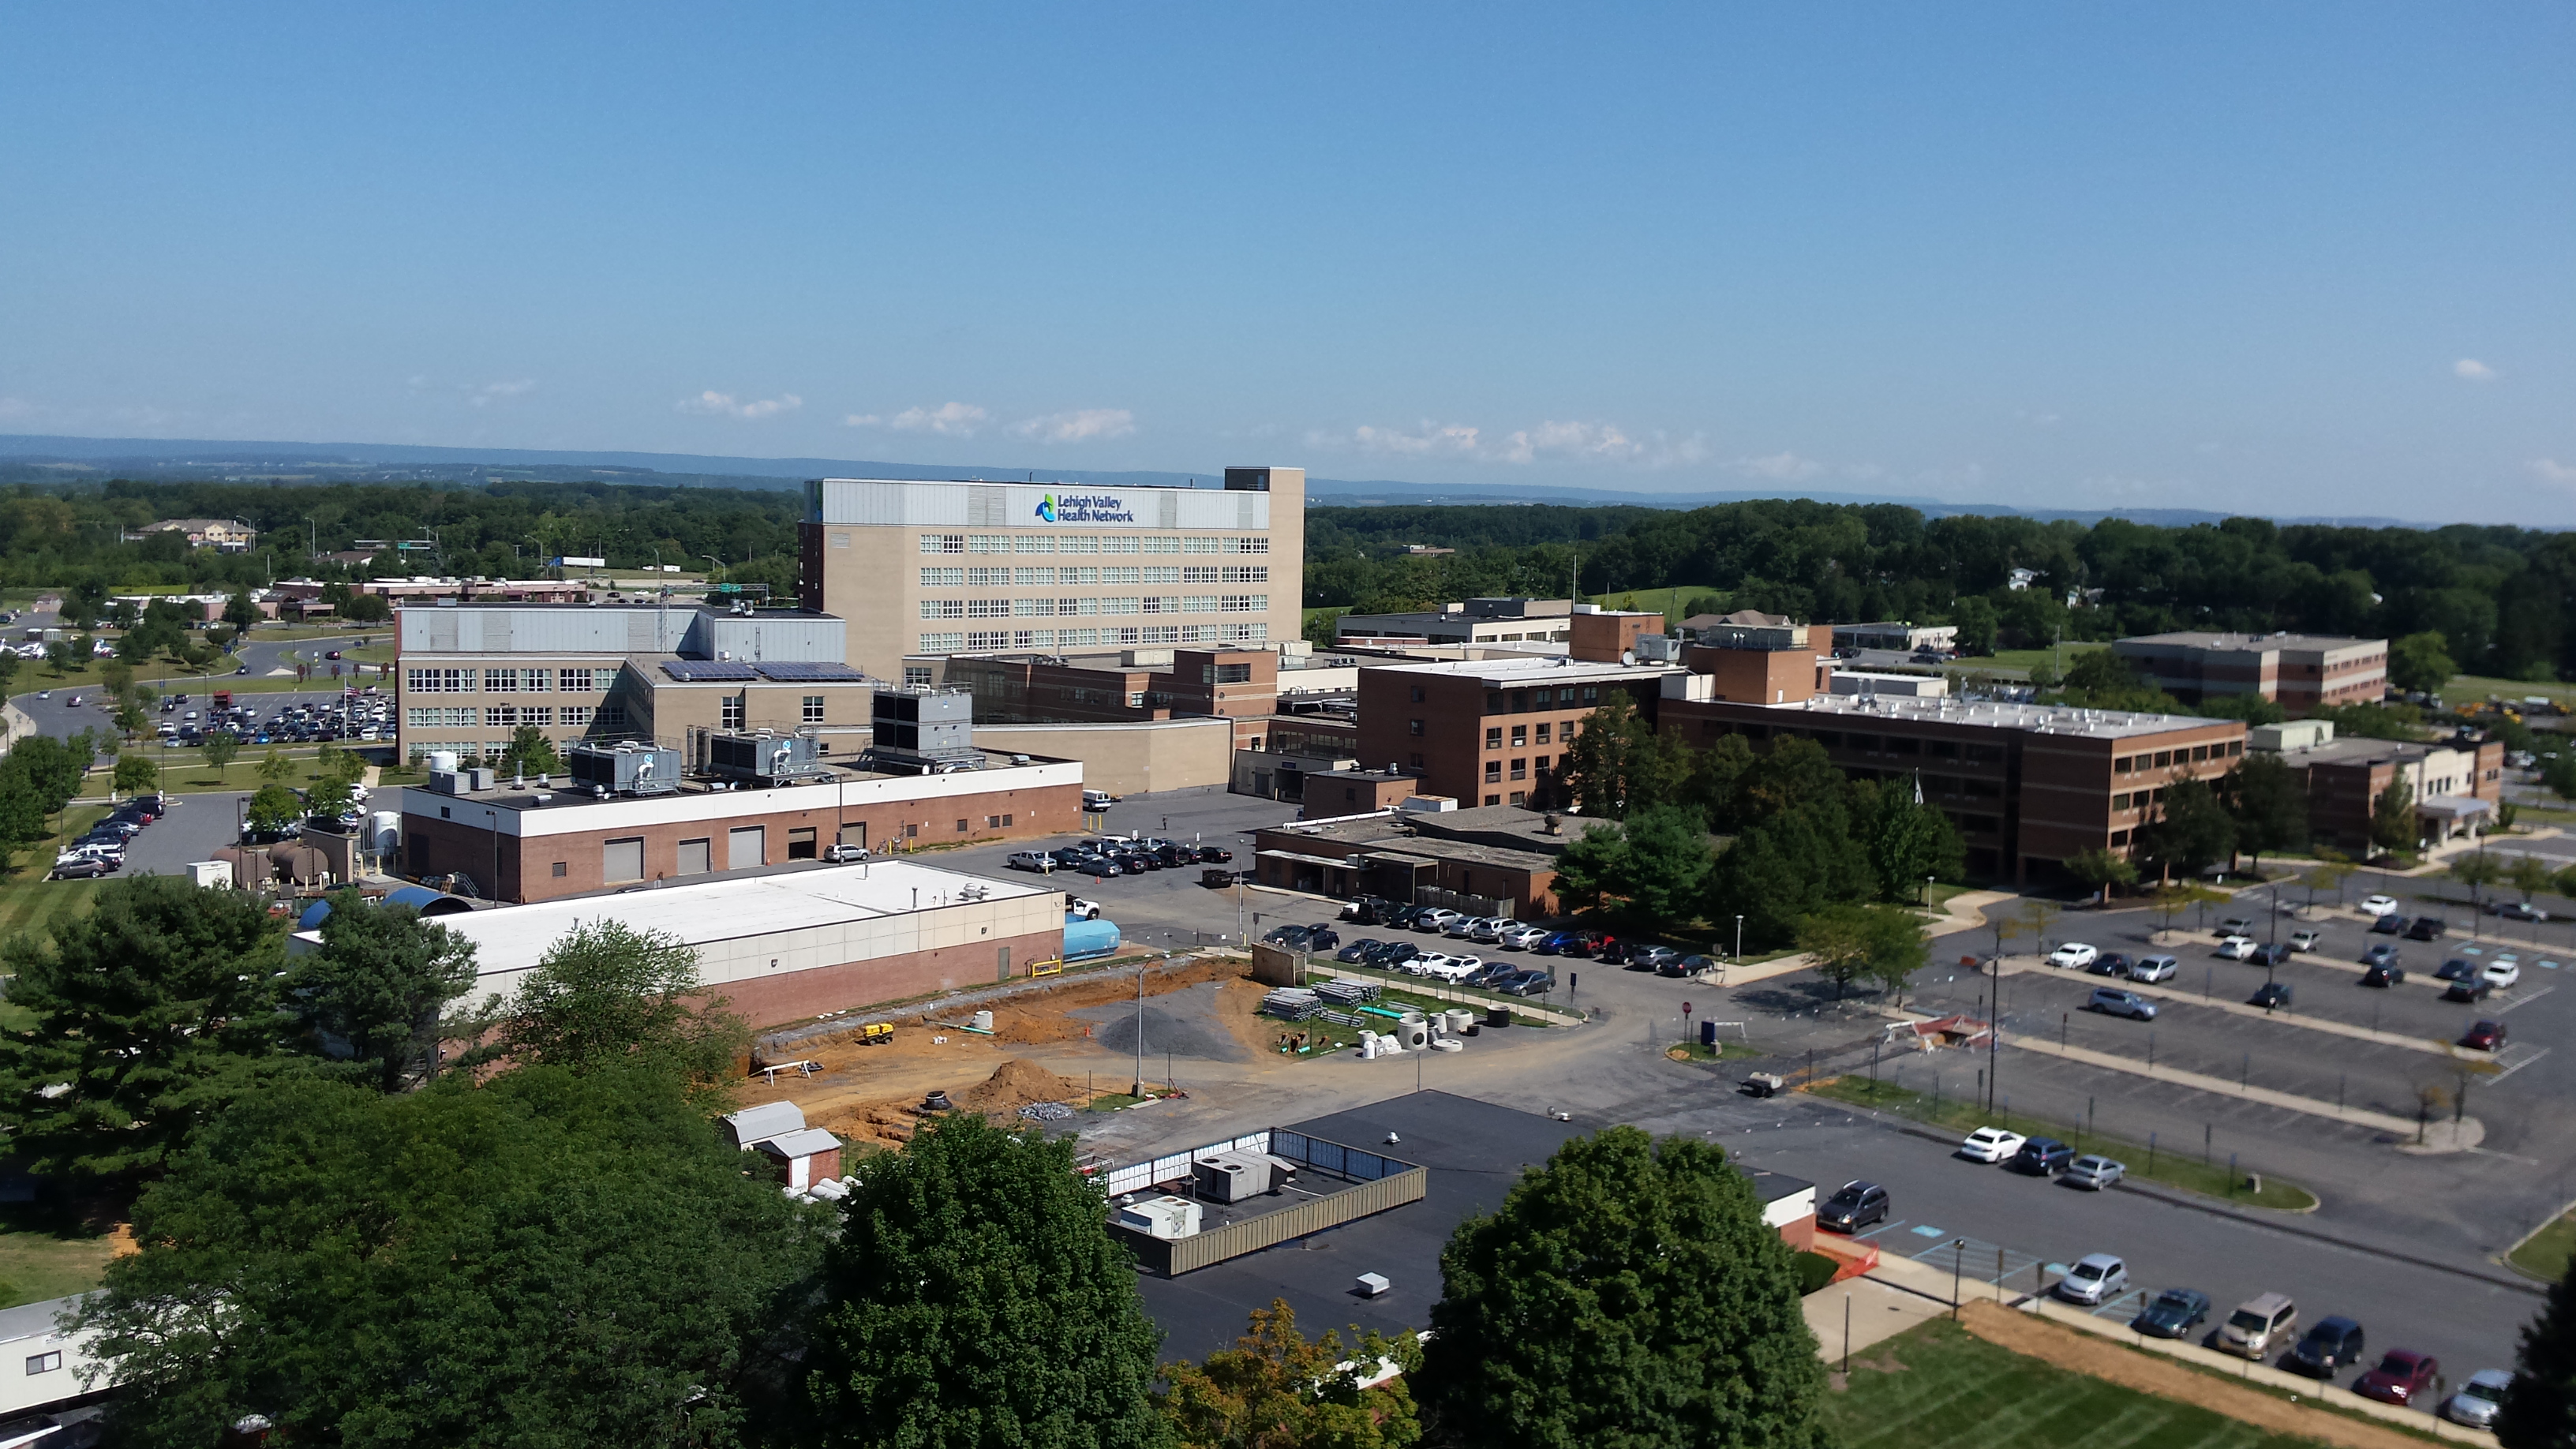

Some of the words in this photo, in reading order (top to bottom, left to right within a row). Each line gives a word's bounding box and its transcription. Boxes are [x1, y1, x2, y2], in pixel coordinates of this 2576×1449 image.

[1058, 494, 1091, 510] Lehigh
[1092, 496, 1121, 511] Valley
[1058, 509, 1090, 521] Health
[1092, 510, 1133, 522] Network
